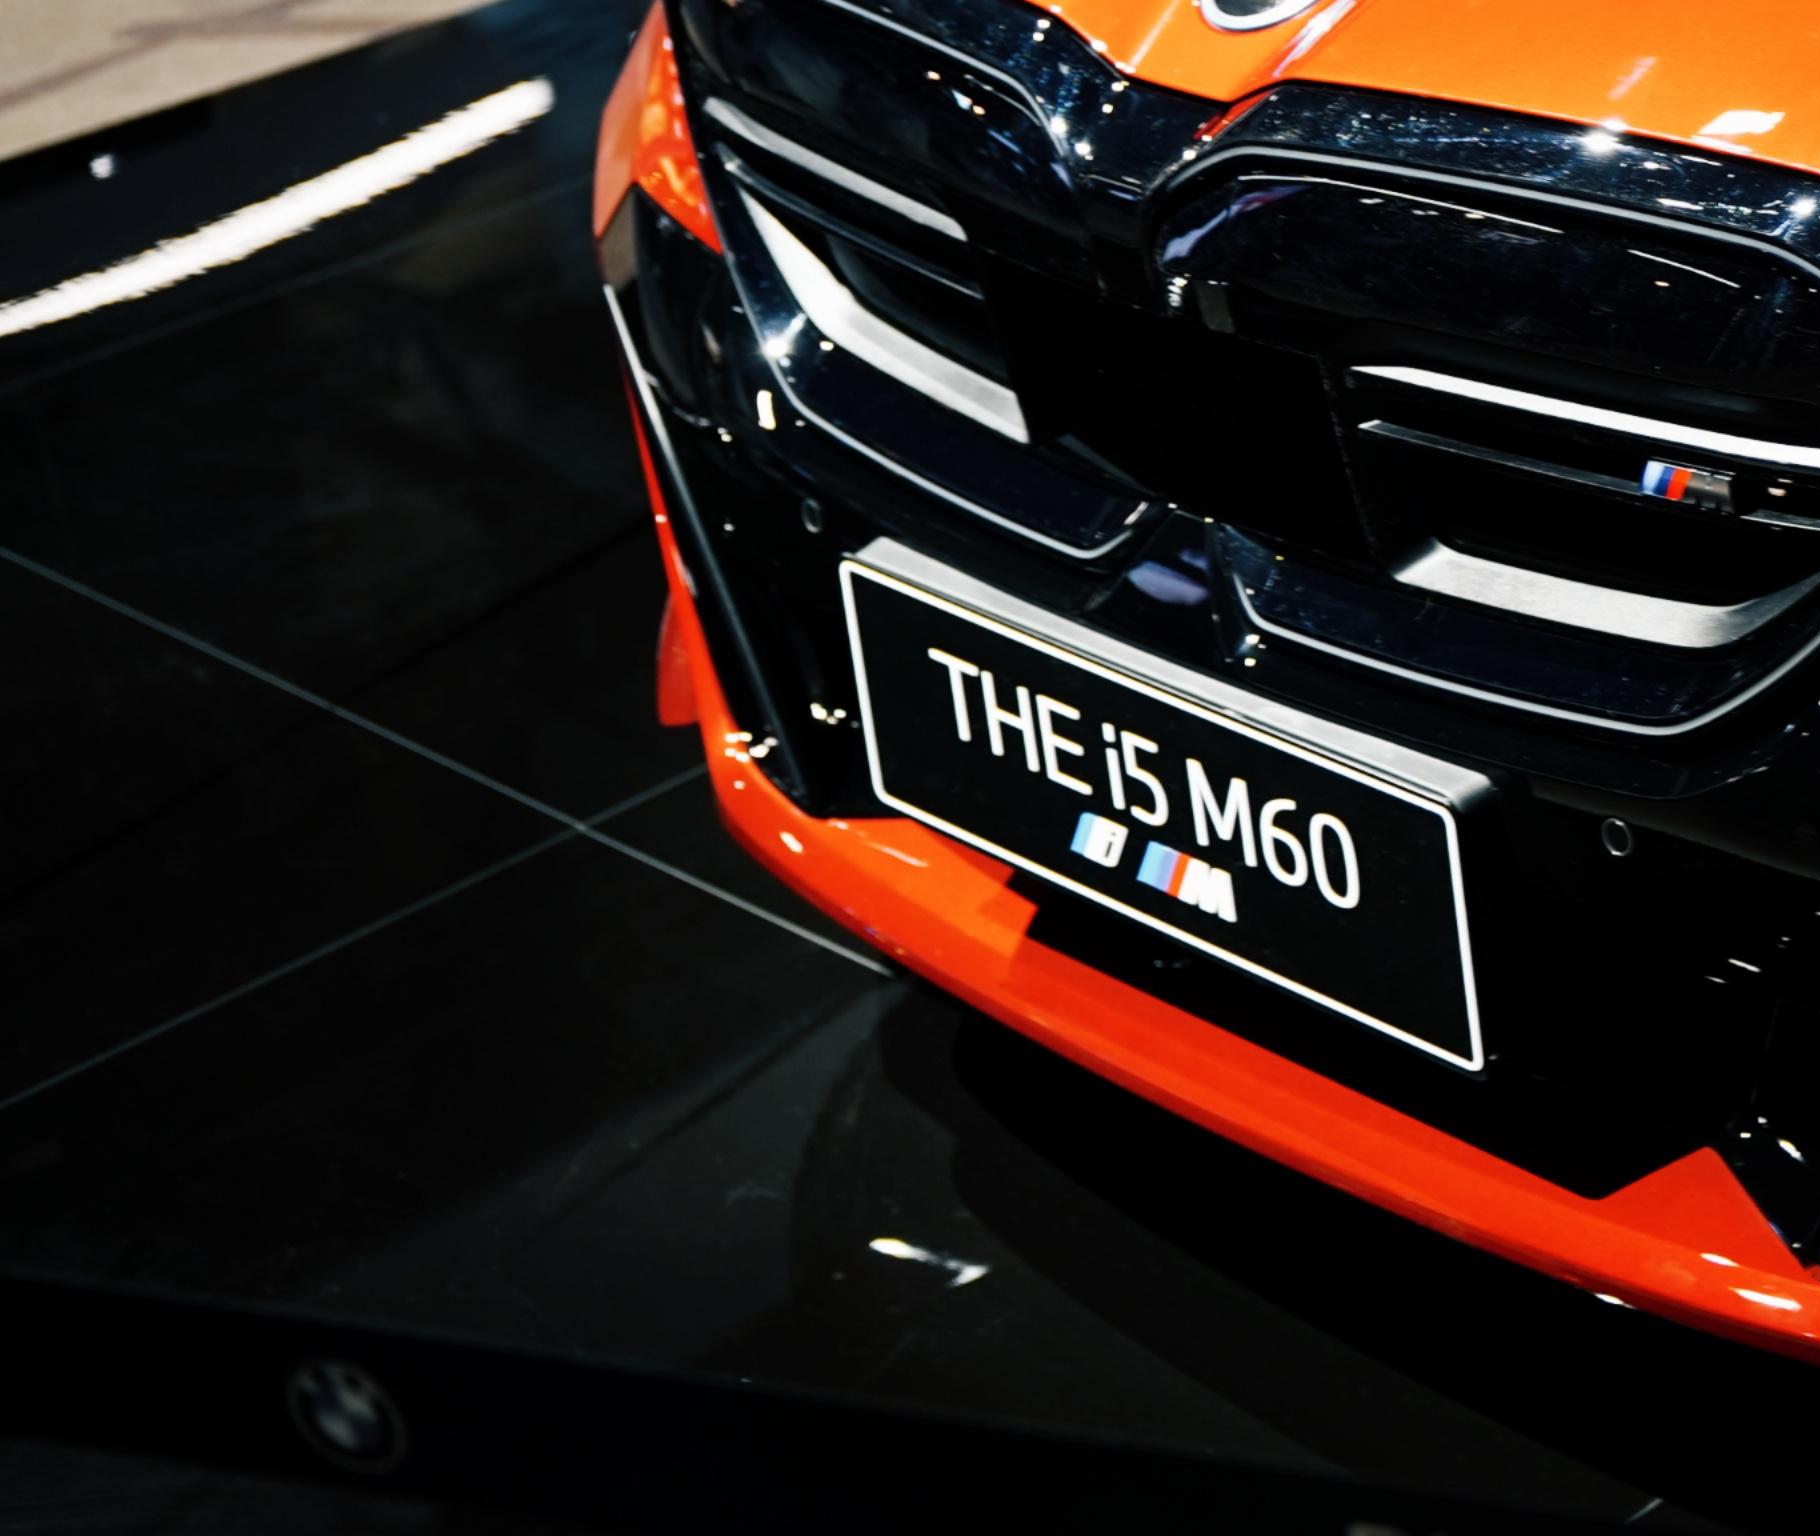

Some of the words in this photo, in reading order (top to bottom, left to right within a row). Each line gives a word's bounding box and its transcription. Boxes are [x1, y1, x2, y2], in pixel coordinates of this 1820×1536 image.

[927, 647, 1093, 796] THE
[1101, 722, 1169, 826] i5
[1186, 757, 1361, 909] M60
